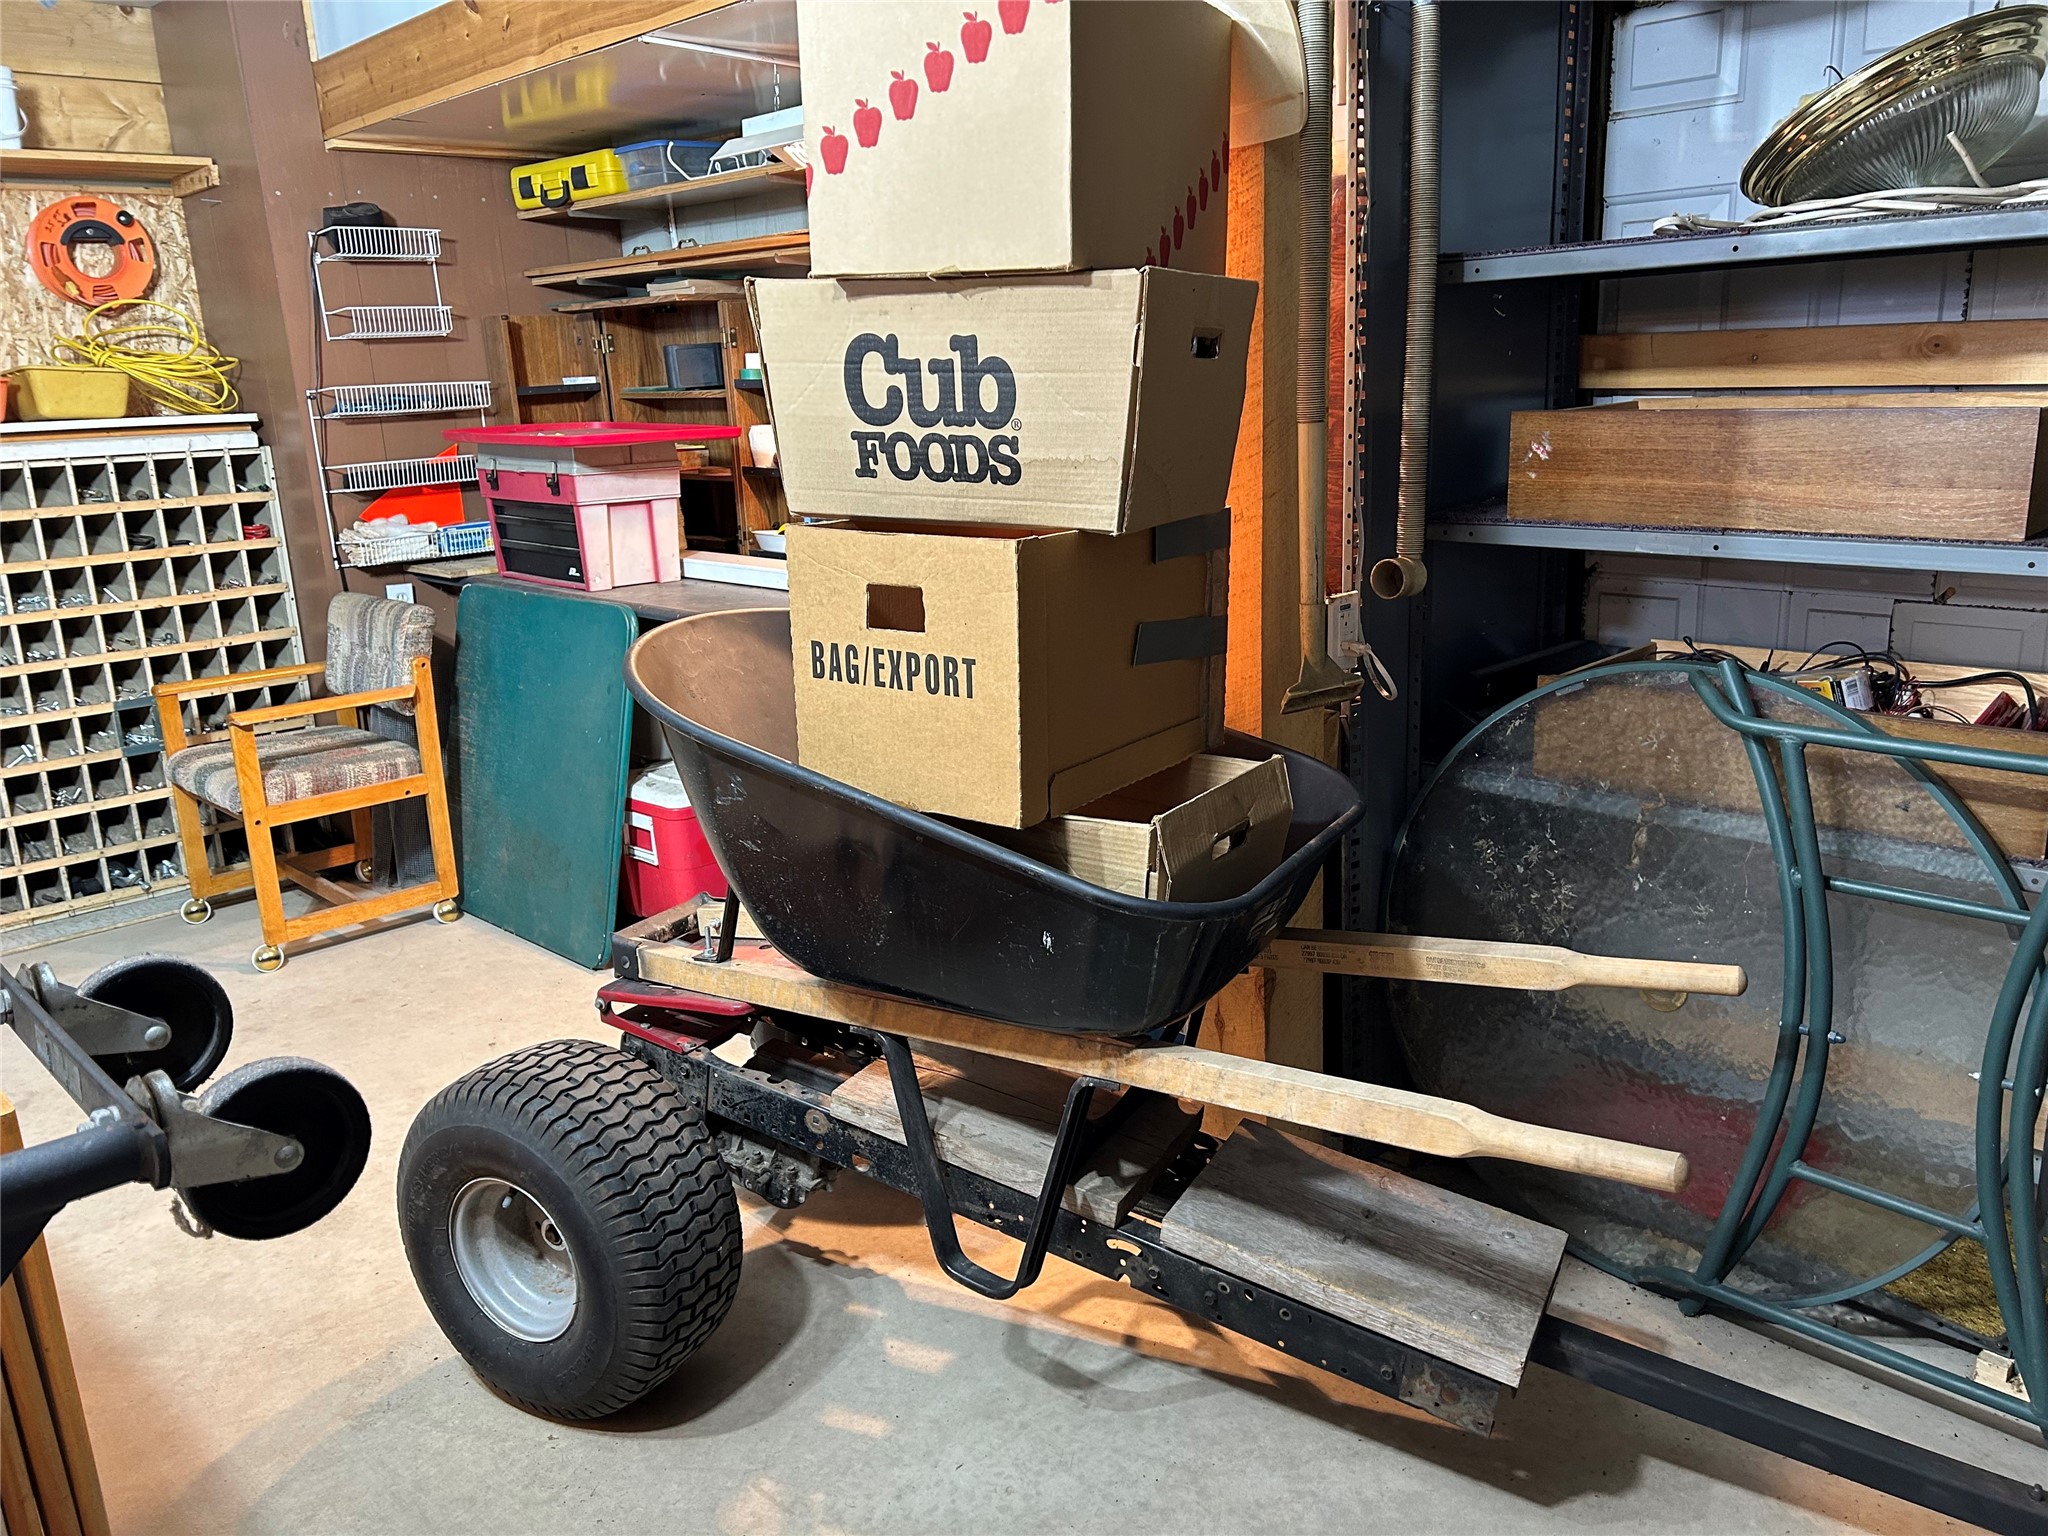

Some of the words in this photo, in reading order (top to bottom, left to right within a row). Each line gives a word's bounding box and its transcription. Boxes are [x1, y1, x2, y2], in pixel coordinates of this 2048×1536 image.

[844, 333, 1017, 430] Cub
[851, 431, 1022, 486] FOODS
[811, 640, 977, 699] BAG/EXPORT
